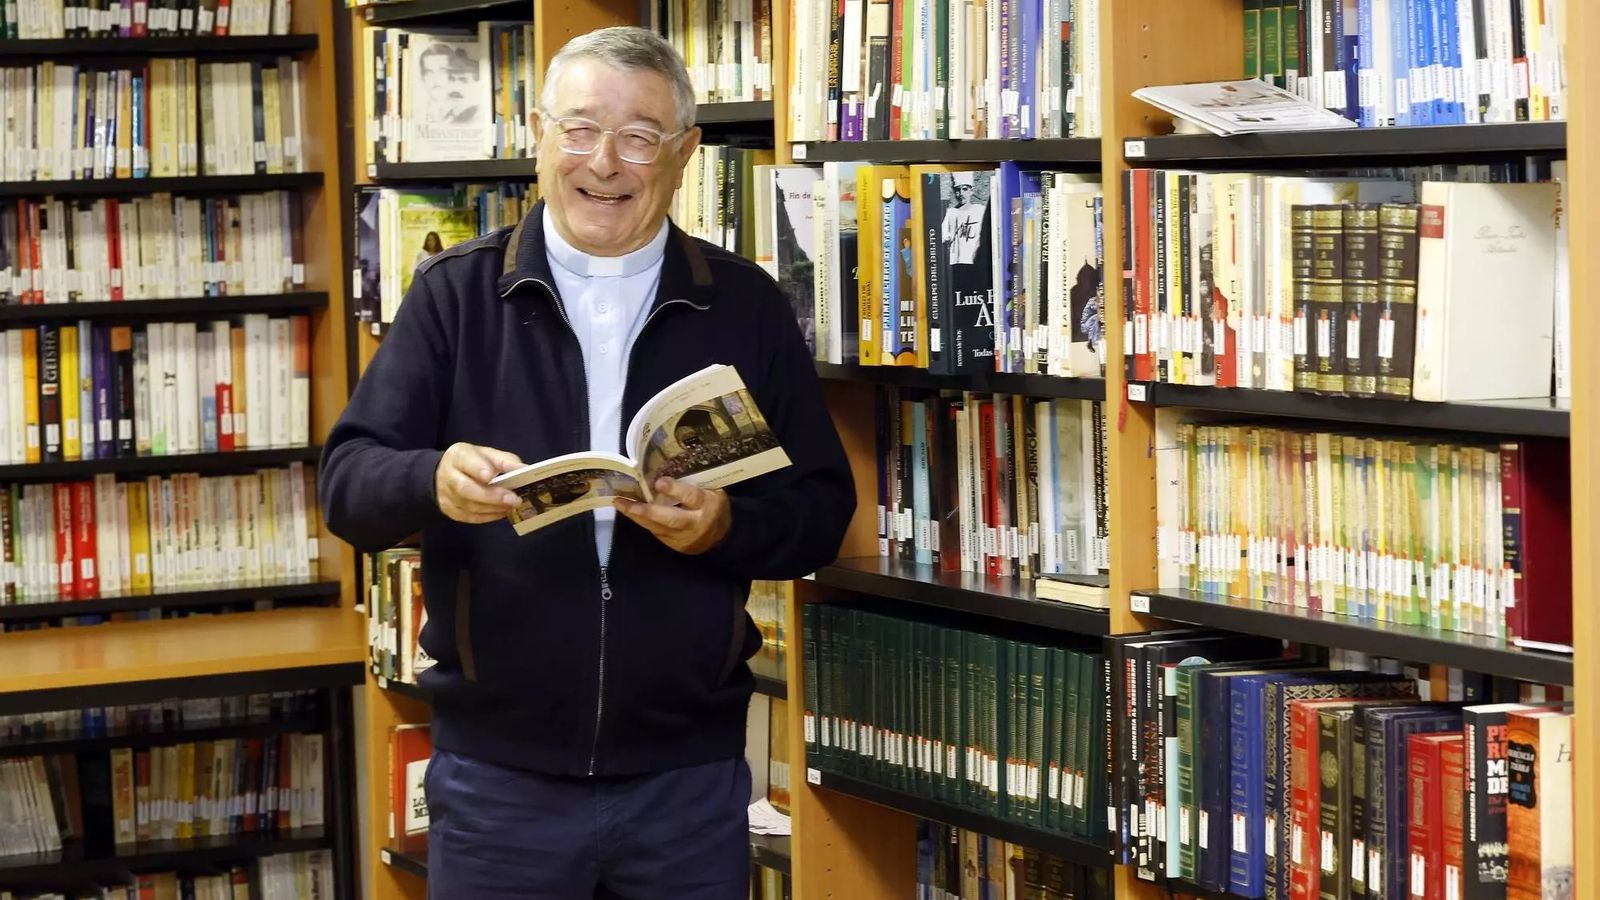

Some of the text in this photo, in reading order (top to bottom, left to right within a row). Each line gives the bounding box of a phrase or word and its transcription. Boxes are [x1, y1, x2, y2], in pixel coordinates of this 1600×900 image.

[1001, 16, 1008, 25] DE
[1324, 11, 1332, 34] Rojas
[929, 228, 937, 262] DELITO
[1042, 220, 1050, 262] ERASMO
[883, 248, 890, 258] DE
[954, 291, 985, 307] Luis
[1061, 313, 1067, 328] LA
[44, 330, 57, 381] GEISHA
[1094, 405, 1102, 466] ultramodernidad
[1027, 427, 1039, 487] ASIMOV
[1095, 474, 1102, 485] de
[1105, 695, 1112, 707] LA
[1105, 708, 1112, 722] DE
[1131, 708, 1138, 718] AL
[1106, 761, 1113, 773] EL
[1469, 780, 1476, 793] AL
